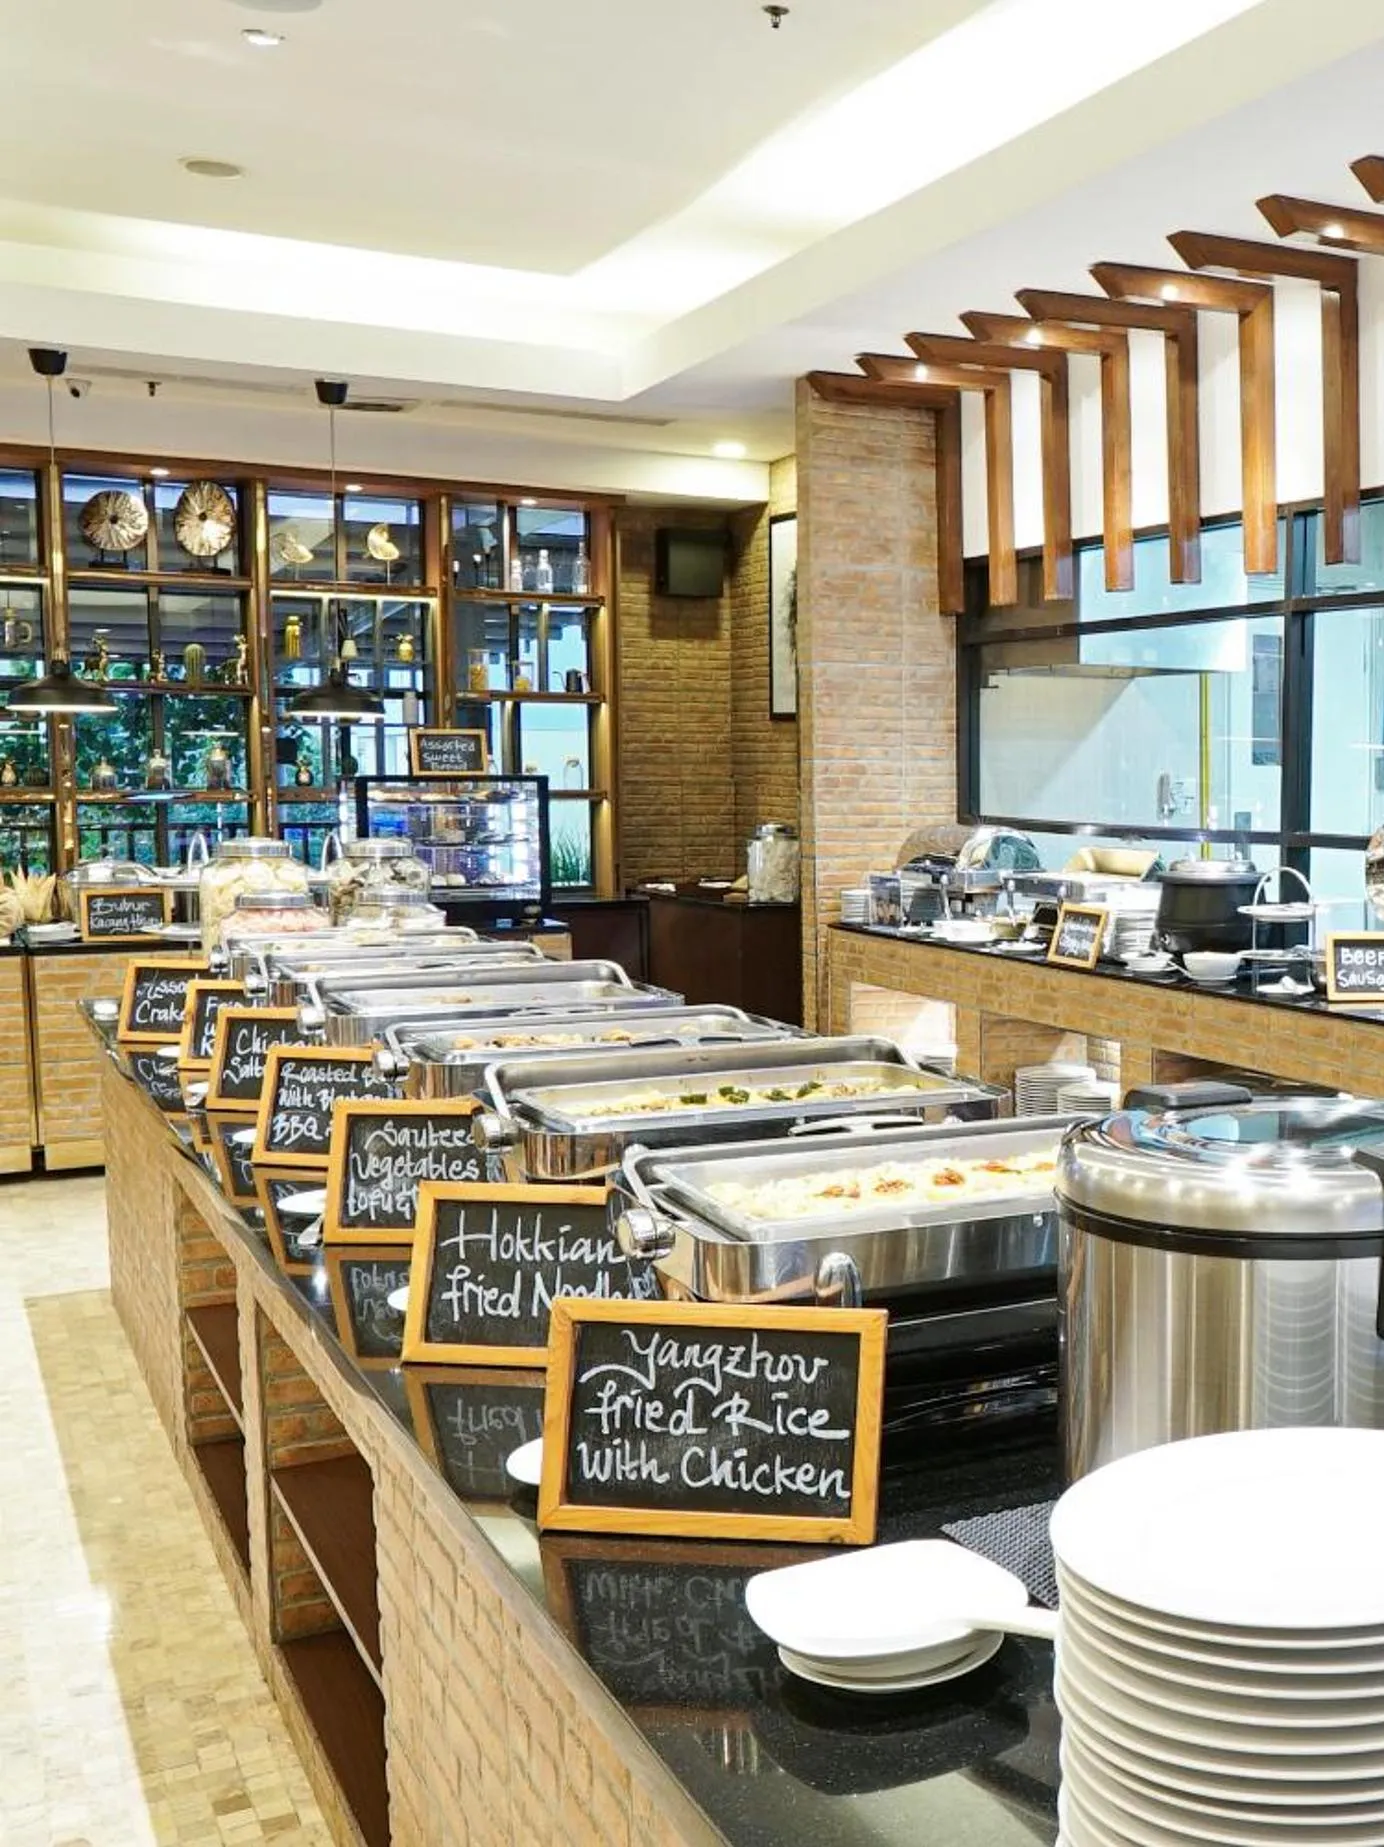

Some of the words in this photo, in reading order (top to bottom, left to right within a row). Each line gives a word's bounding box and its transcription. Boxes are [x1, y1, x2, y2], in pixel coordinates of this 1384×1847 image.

[421, 739, 476, 752] Assorted
[422, 752, 463, 763] Sweet
[272, 1113, 324, 1145] BBQ
[440, 1208, 626, 1263] Hokkian
[441, 1265, 521, 1322] fried
[584, 1379, 708, 1435] fried
[711, 1391, 851, 1440] Rice
[680, 1445, 851, 1499] Chicken
